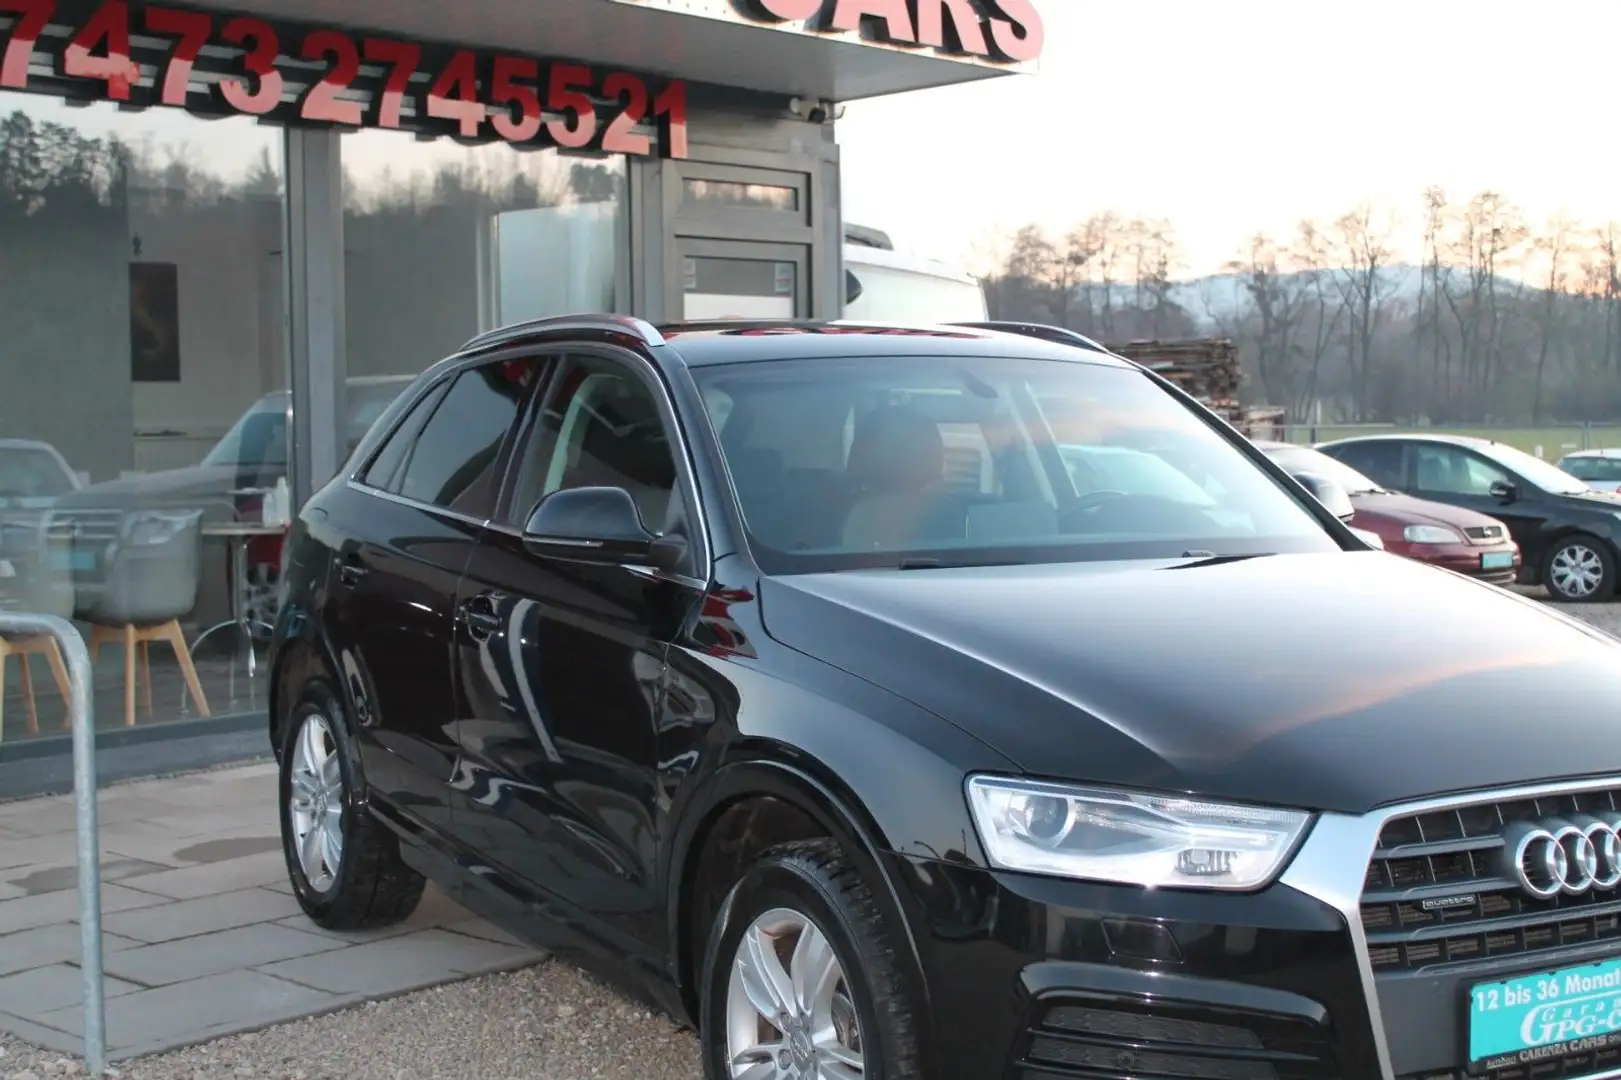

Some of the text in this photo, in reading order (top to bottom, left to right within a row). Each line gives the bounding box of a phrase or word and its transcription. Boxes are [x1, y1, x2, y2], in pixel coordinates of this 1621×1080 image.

[1424, 896, 1474, 908] quattro
[1477, 990, 1499, 1012] 12
[1505, 983, 1531, 1006] bis
[1536, 978, 1559, 1001] 36
[1519, 1042, 1569, 1062] CARENZA
[1569, 1035, 1607, 1052] CARS
